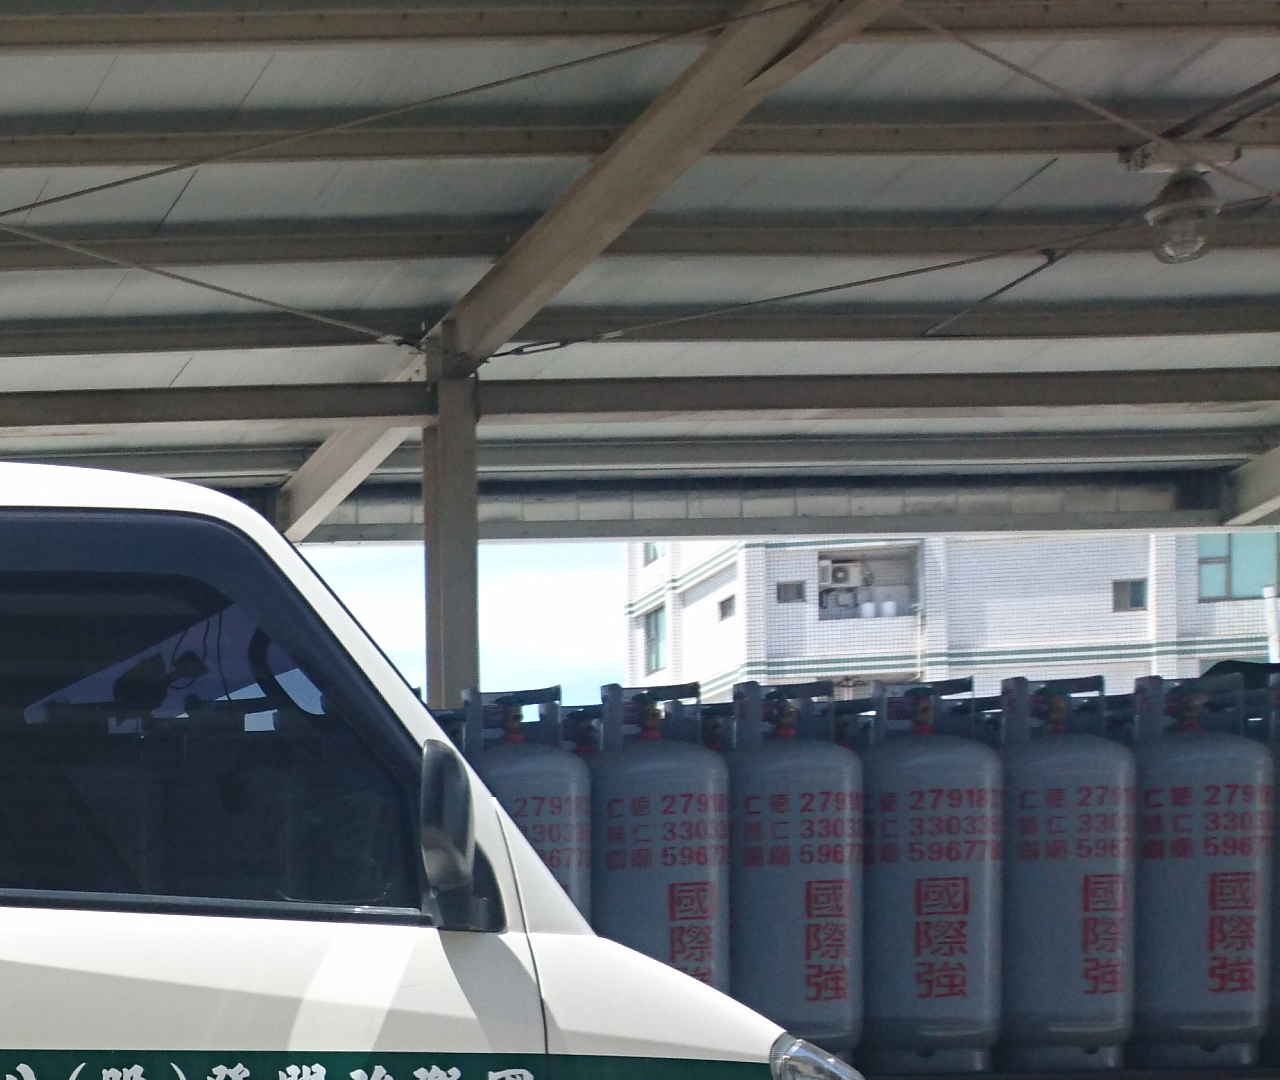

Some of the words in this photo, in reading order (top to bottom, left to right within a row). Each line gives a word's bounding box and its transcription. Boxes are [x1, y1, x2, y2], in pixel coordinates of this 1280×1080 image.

[914, 876, 970, 999] 國際強
[1207, 871, 1259, 993] 國際強
